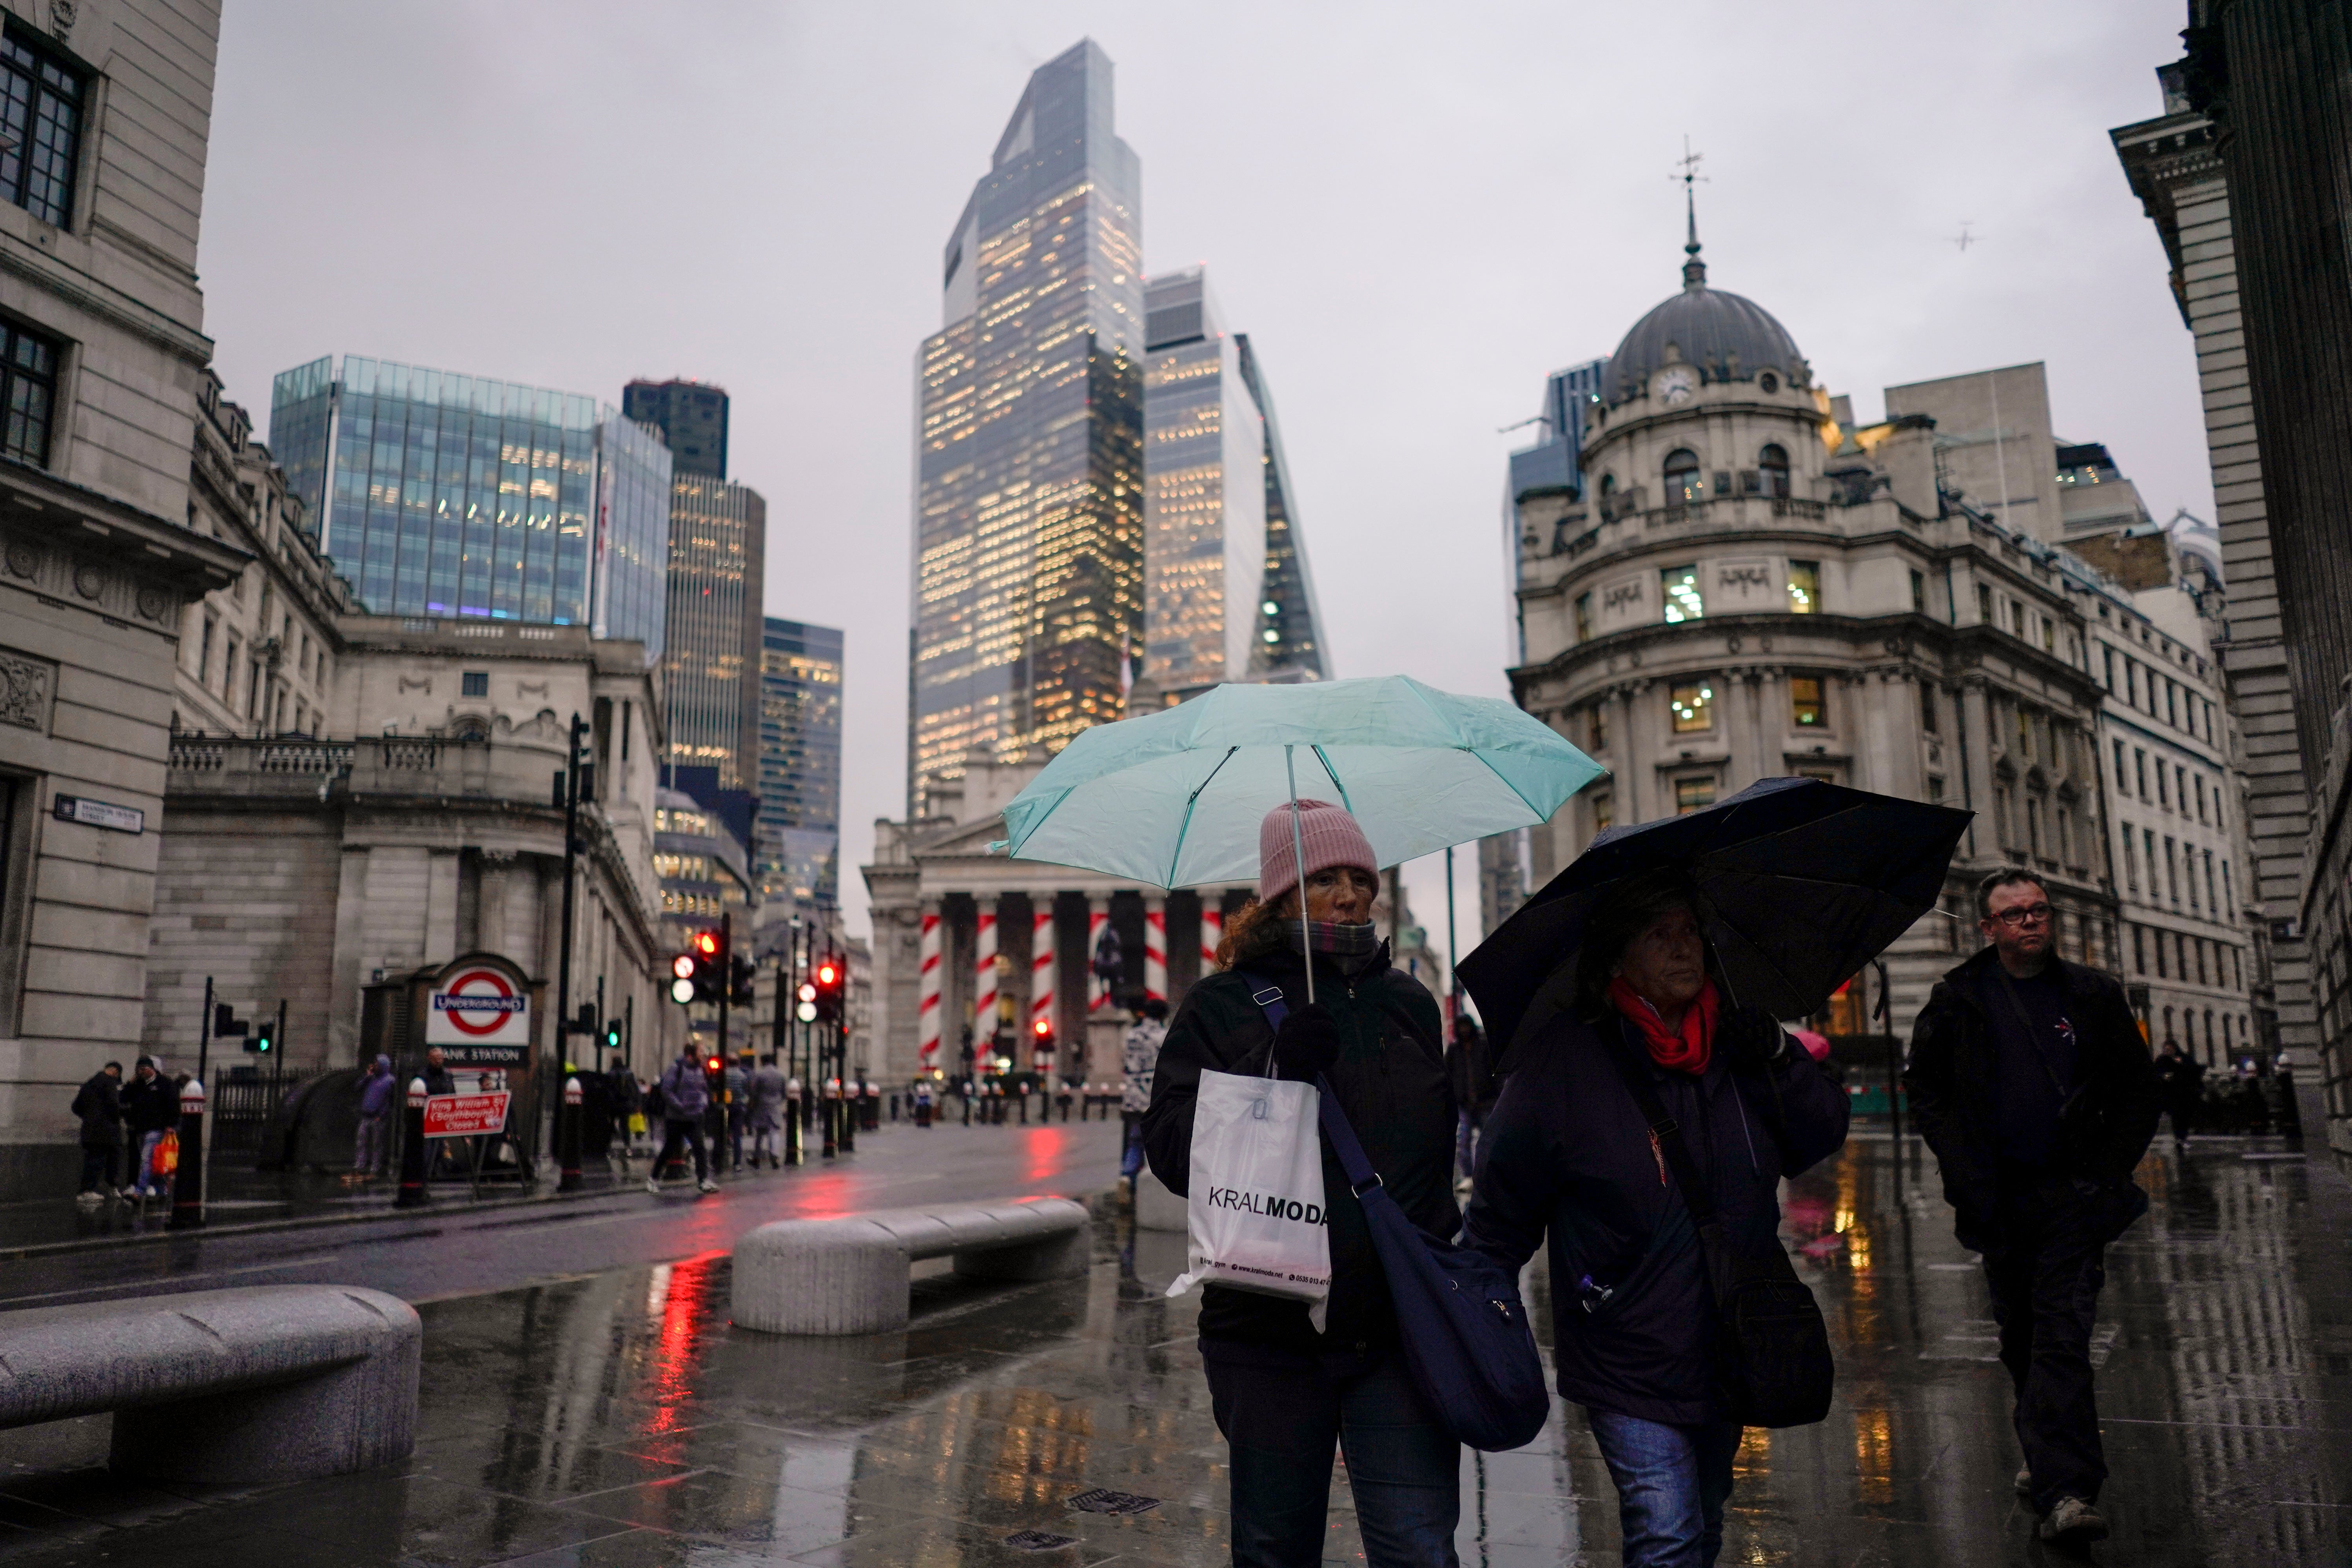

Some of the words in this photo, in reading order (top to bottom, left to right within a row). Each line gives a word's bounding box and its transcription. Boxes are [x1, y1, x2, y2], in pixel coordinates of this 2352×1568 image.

[437, 995, 522, 1011] UNDERGROUND
[443, 1048, 466, 1061] ANK
[472, 1048, 519, 1061] STATION
[431, 1100, 452, 1112] King
[455, 1098, 490, 1109] William
[430, 1106, 500, 1122] (Southbound)
[445, 1119, 480, 1131] Closed
[1238, 1265, 1283, 1278] www.kralmoda.net
[1296, 1274, 1308, 1283] 0535
